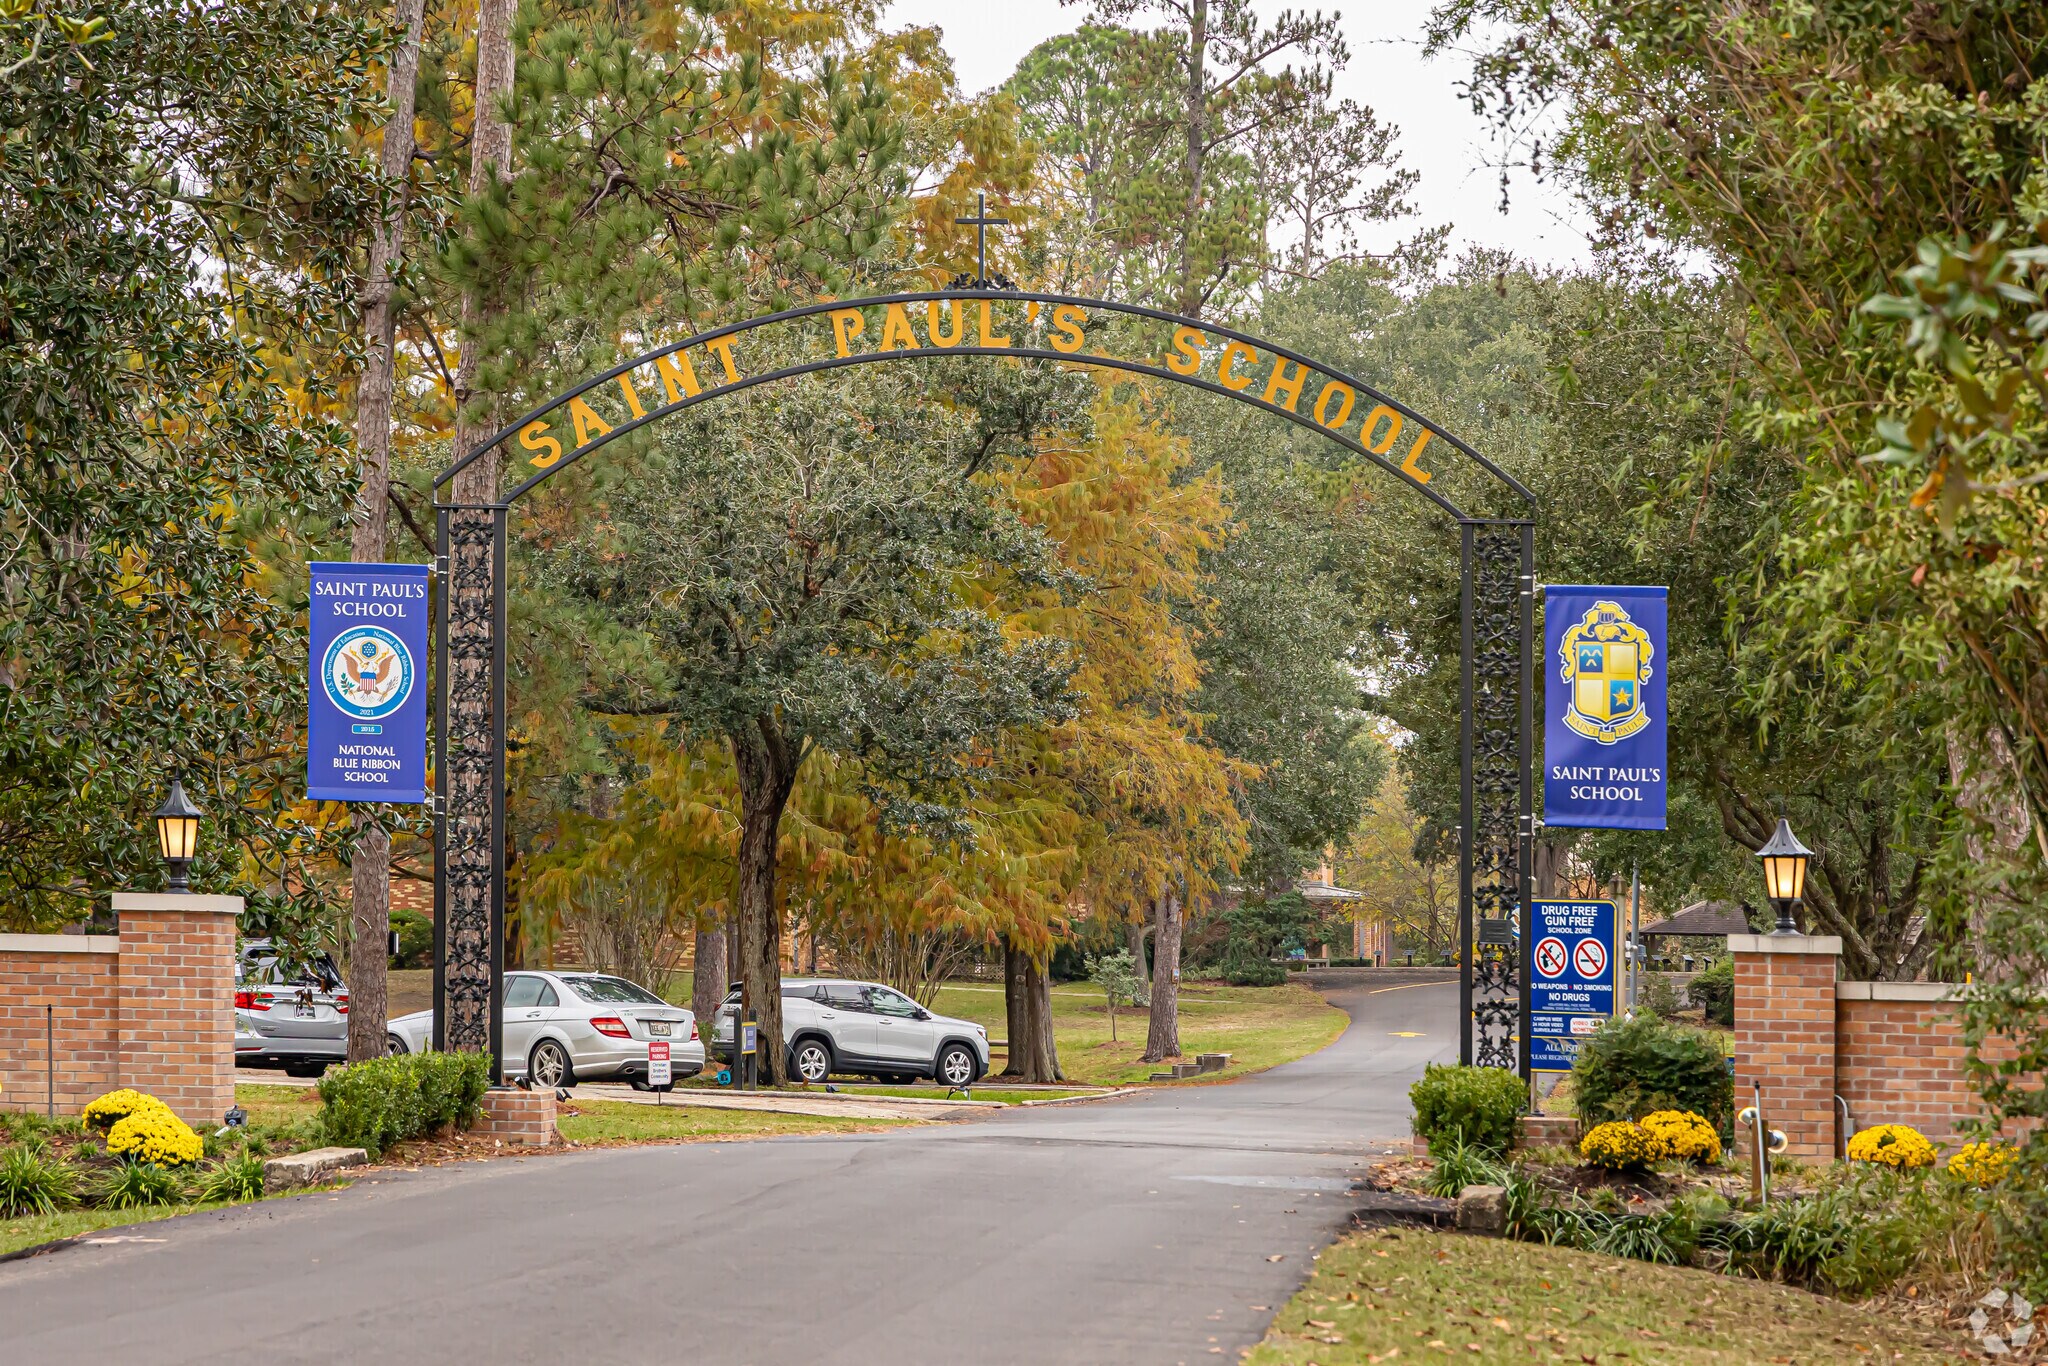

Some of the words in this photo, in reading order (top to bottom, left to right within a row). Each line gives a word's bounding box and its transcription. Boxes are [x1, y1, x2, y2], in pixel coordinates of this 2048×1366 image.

[519, 334, 742, 468] SAINT
[829, 299, 1089, 359] PAUL'S
[1165, 326, 1432, 484] SCHOOL
[315, 581, 367, 597] SAINT
[372, 583, 425, 599] PAUL'S
[333, 602, 407, 618] SCHOOL
[372, 630, 394, 645] National
[326, 648, 338, 680] Department
[339, 631, 366, 645] Education
[393, 643, 403, 655] Blue
[400, 654, 410, 676] Ribbon
[399, 676, 410, 695] School
[359, 708, 374, 716] 2021
[1571, 715, 1598, 735] SAINT
[338, 744, 396, 757] NATIONAL
[333, 757, 359, 769] BLUE
[361, 758, 401, 770] RIBBON
[344, 771, 389, 783] SCHOOL
[1552, 765, 1604, 781] SAINT
[1608, 767, 1661, 782] PAUL'S
[1570, 785, 1643, 801] SCHOOL
[1541, 905, 1570, 915] DRUG
[1571, 906, 1598, 916] FREE
[1545, 916, 1567, 926] GUN
[1568, 916, 1595, 927] FREE
[1547, 926, 1573, 934] SCHOOL
[1574, 927, 1592, 935] ZONE
[1583, 984, 1613, 992] SMOKING
[1548, 992, 1561, 1001] NO
[1562, 993, 1590, 1002] DRUGS
[1545, 1043, 1559, 1052] ALL
